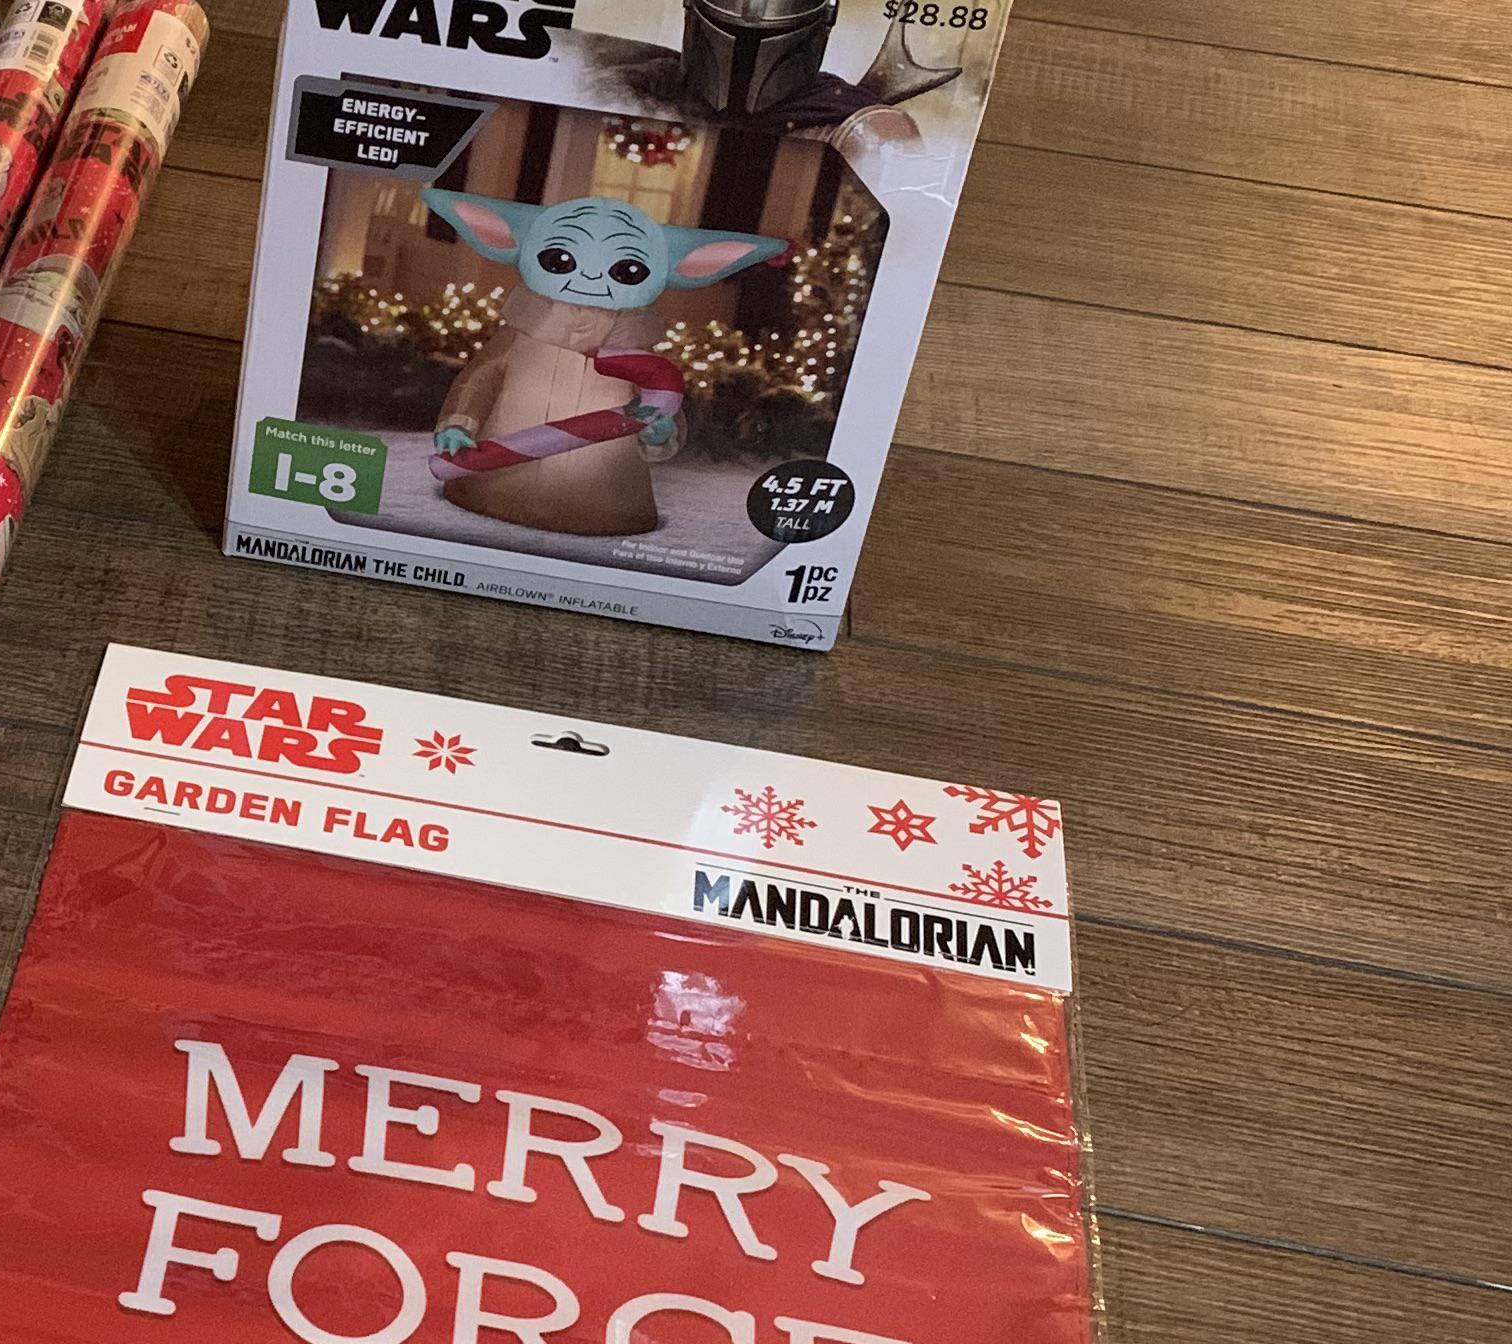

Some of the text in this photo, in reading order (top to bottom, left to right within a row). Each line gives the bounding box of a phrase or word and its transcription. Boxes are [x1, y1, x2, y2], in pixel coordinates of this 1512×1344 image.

[883, 0, 988, 30] $28.88
[341, 97, 426, 123] ENERGY-
[333, 118, 430, 146] EFFICIENT
[265, 426, 377, 456] Match this letter
[761, 474, 848, 497] 4.5 FT
[769, 497, 834, 514] 1.37 M
[775, 516, 811, 531] TALL
[236, 534, 366, 573] MANDALORIAN
[372, 558, 407, 578] THE
[558, 593, 639, 616] INFLATABLE
[806, 565, 839, 584] pc
[801, 584, 833, 604] pz
[126, 674, 383, 740] STAR
[125, 701, 381, 774] WARS
[104, 769, 450, 852] GARDEN FLAG
[842, 885, 881, 898] THE
[692, 870, 1036, 976] MANDALORIAN
[168, 1037, 932, 1286] MERRY
